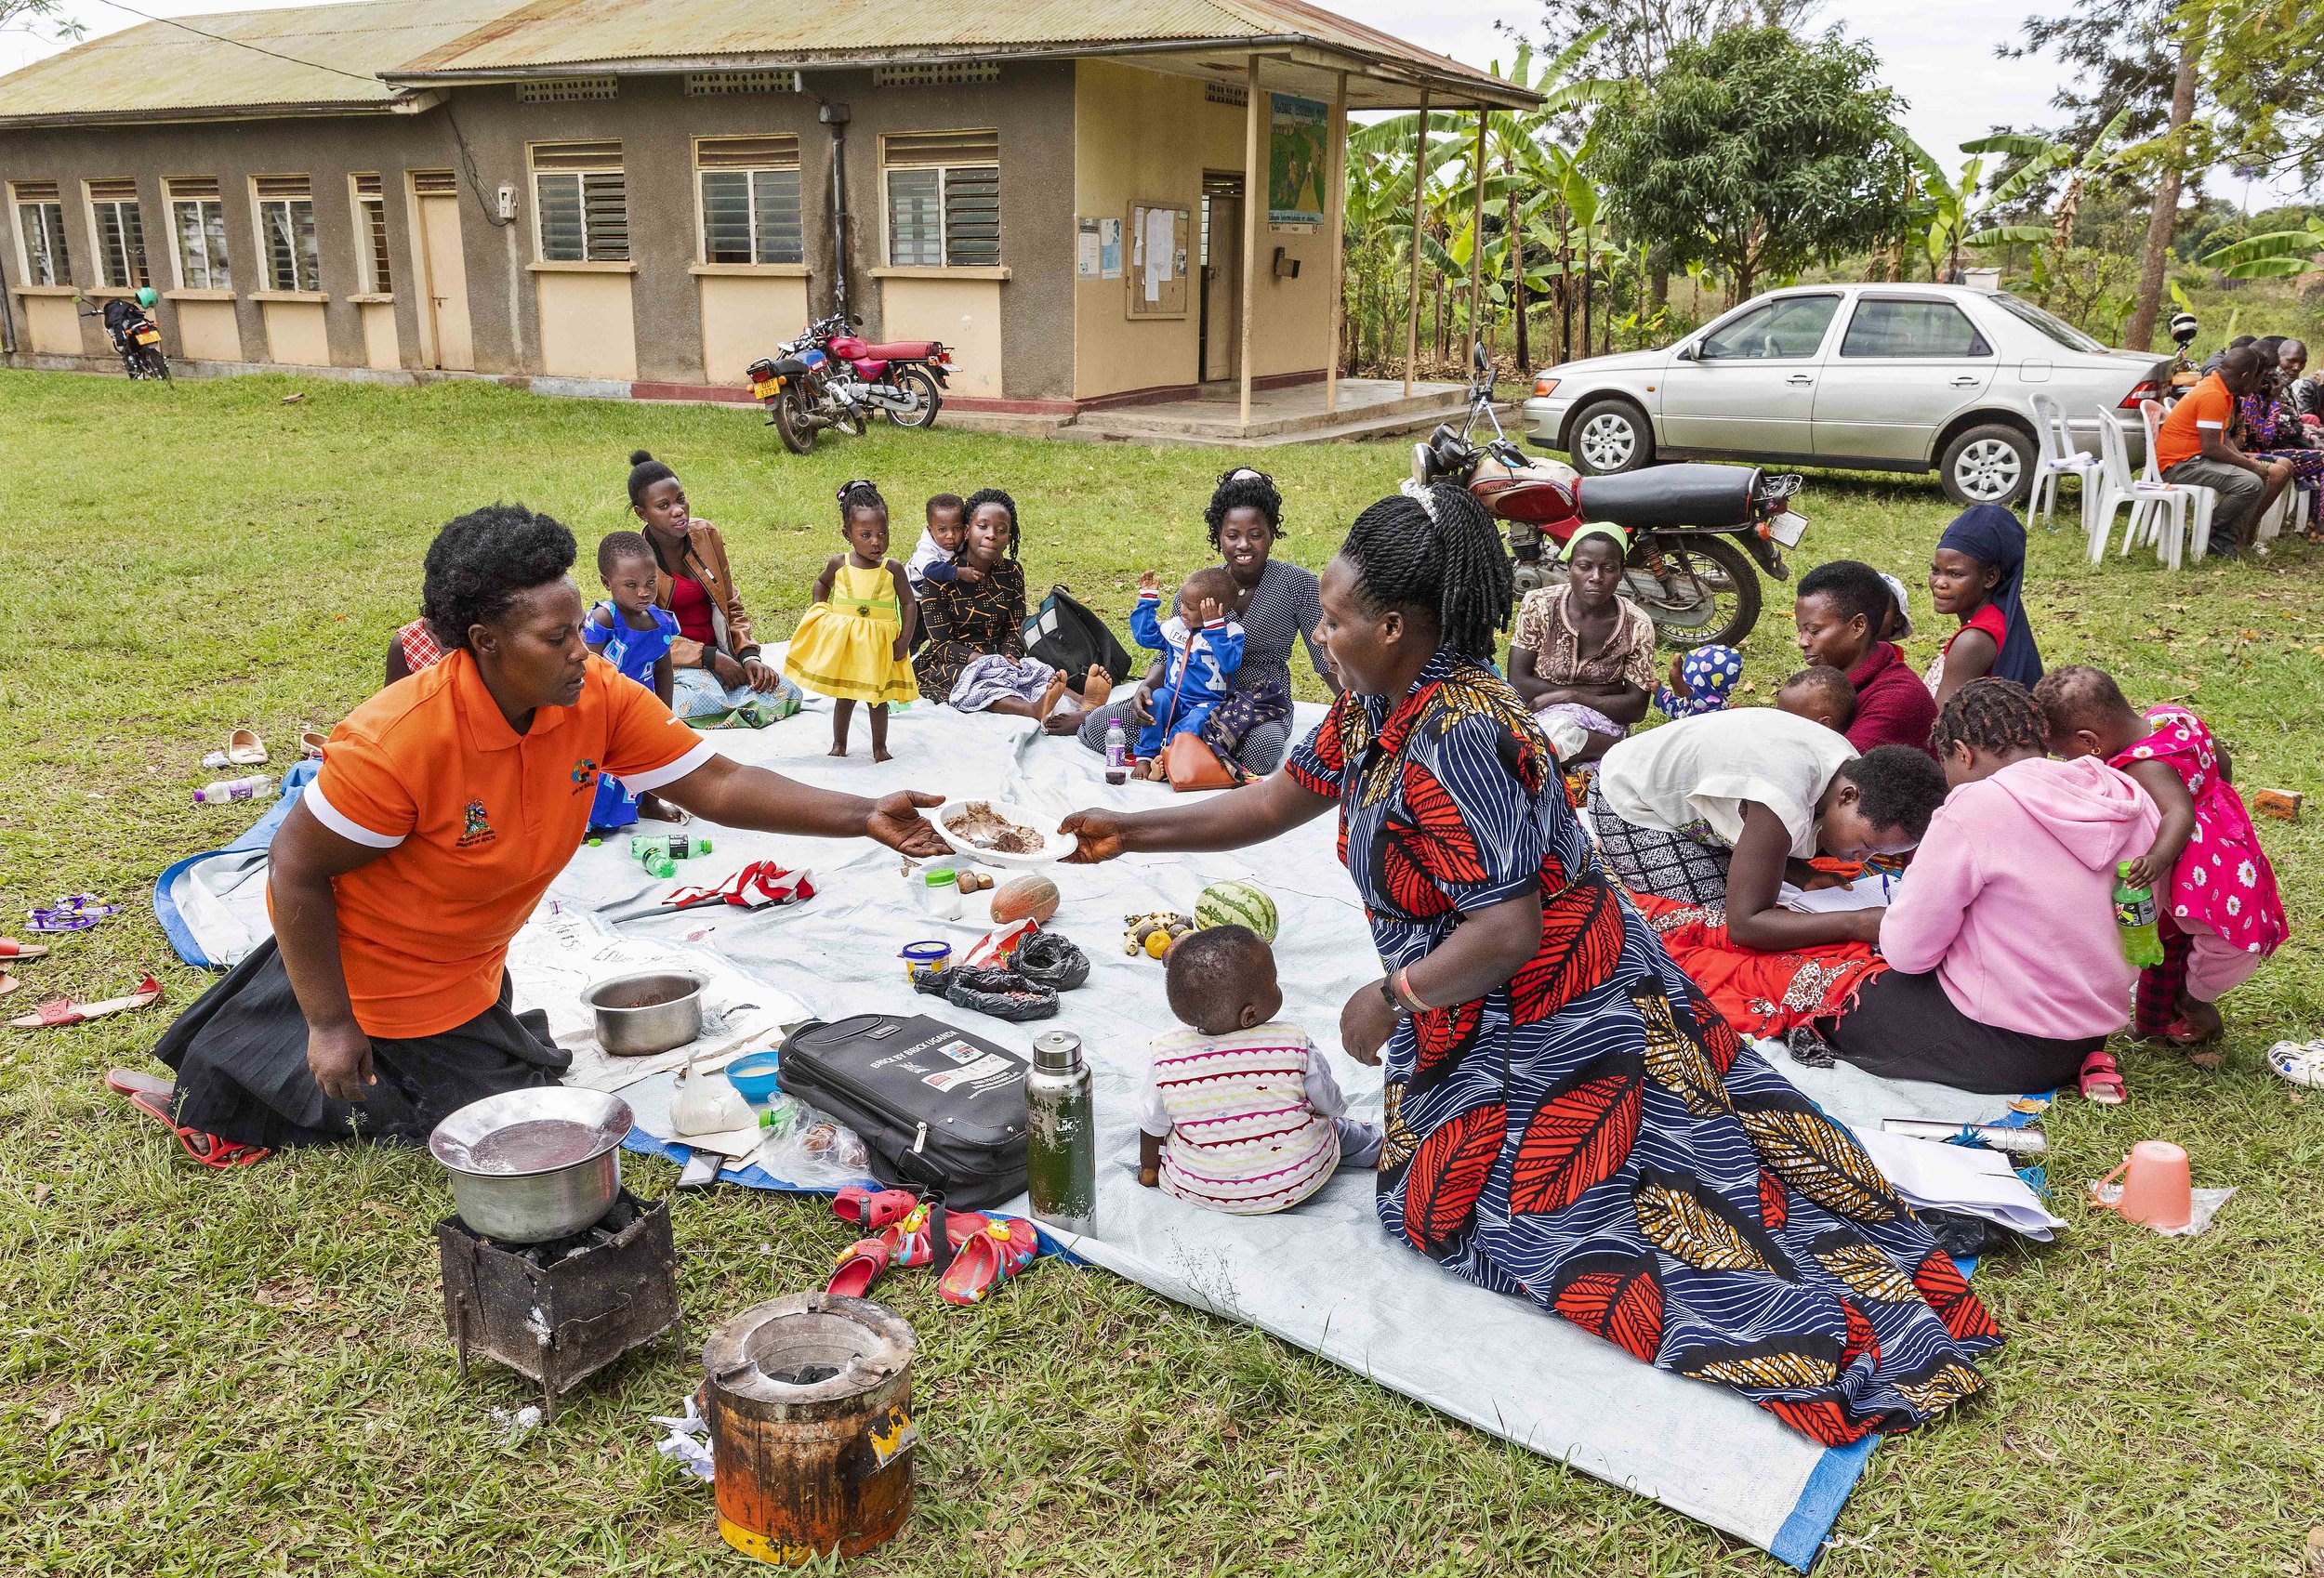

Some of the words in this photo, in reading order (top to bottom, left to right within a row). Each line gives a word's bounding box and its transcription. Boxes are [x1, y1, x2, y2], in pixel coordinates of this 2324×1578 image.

[760, 387, 777, 397] 337Y
[869, 1057, 898, 1069] BRICK
[892, 1052, 906, 1061] BY
[903, 1042, 931, 1057] BRICK
[925, 1030, 960, 1045] UGANDA
